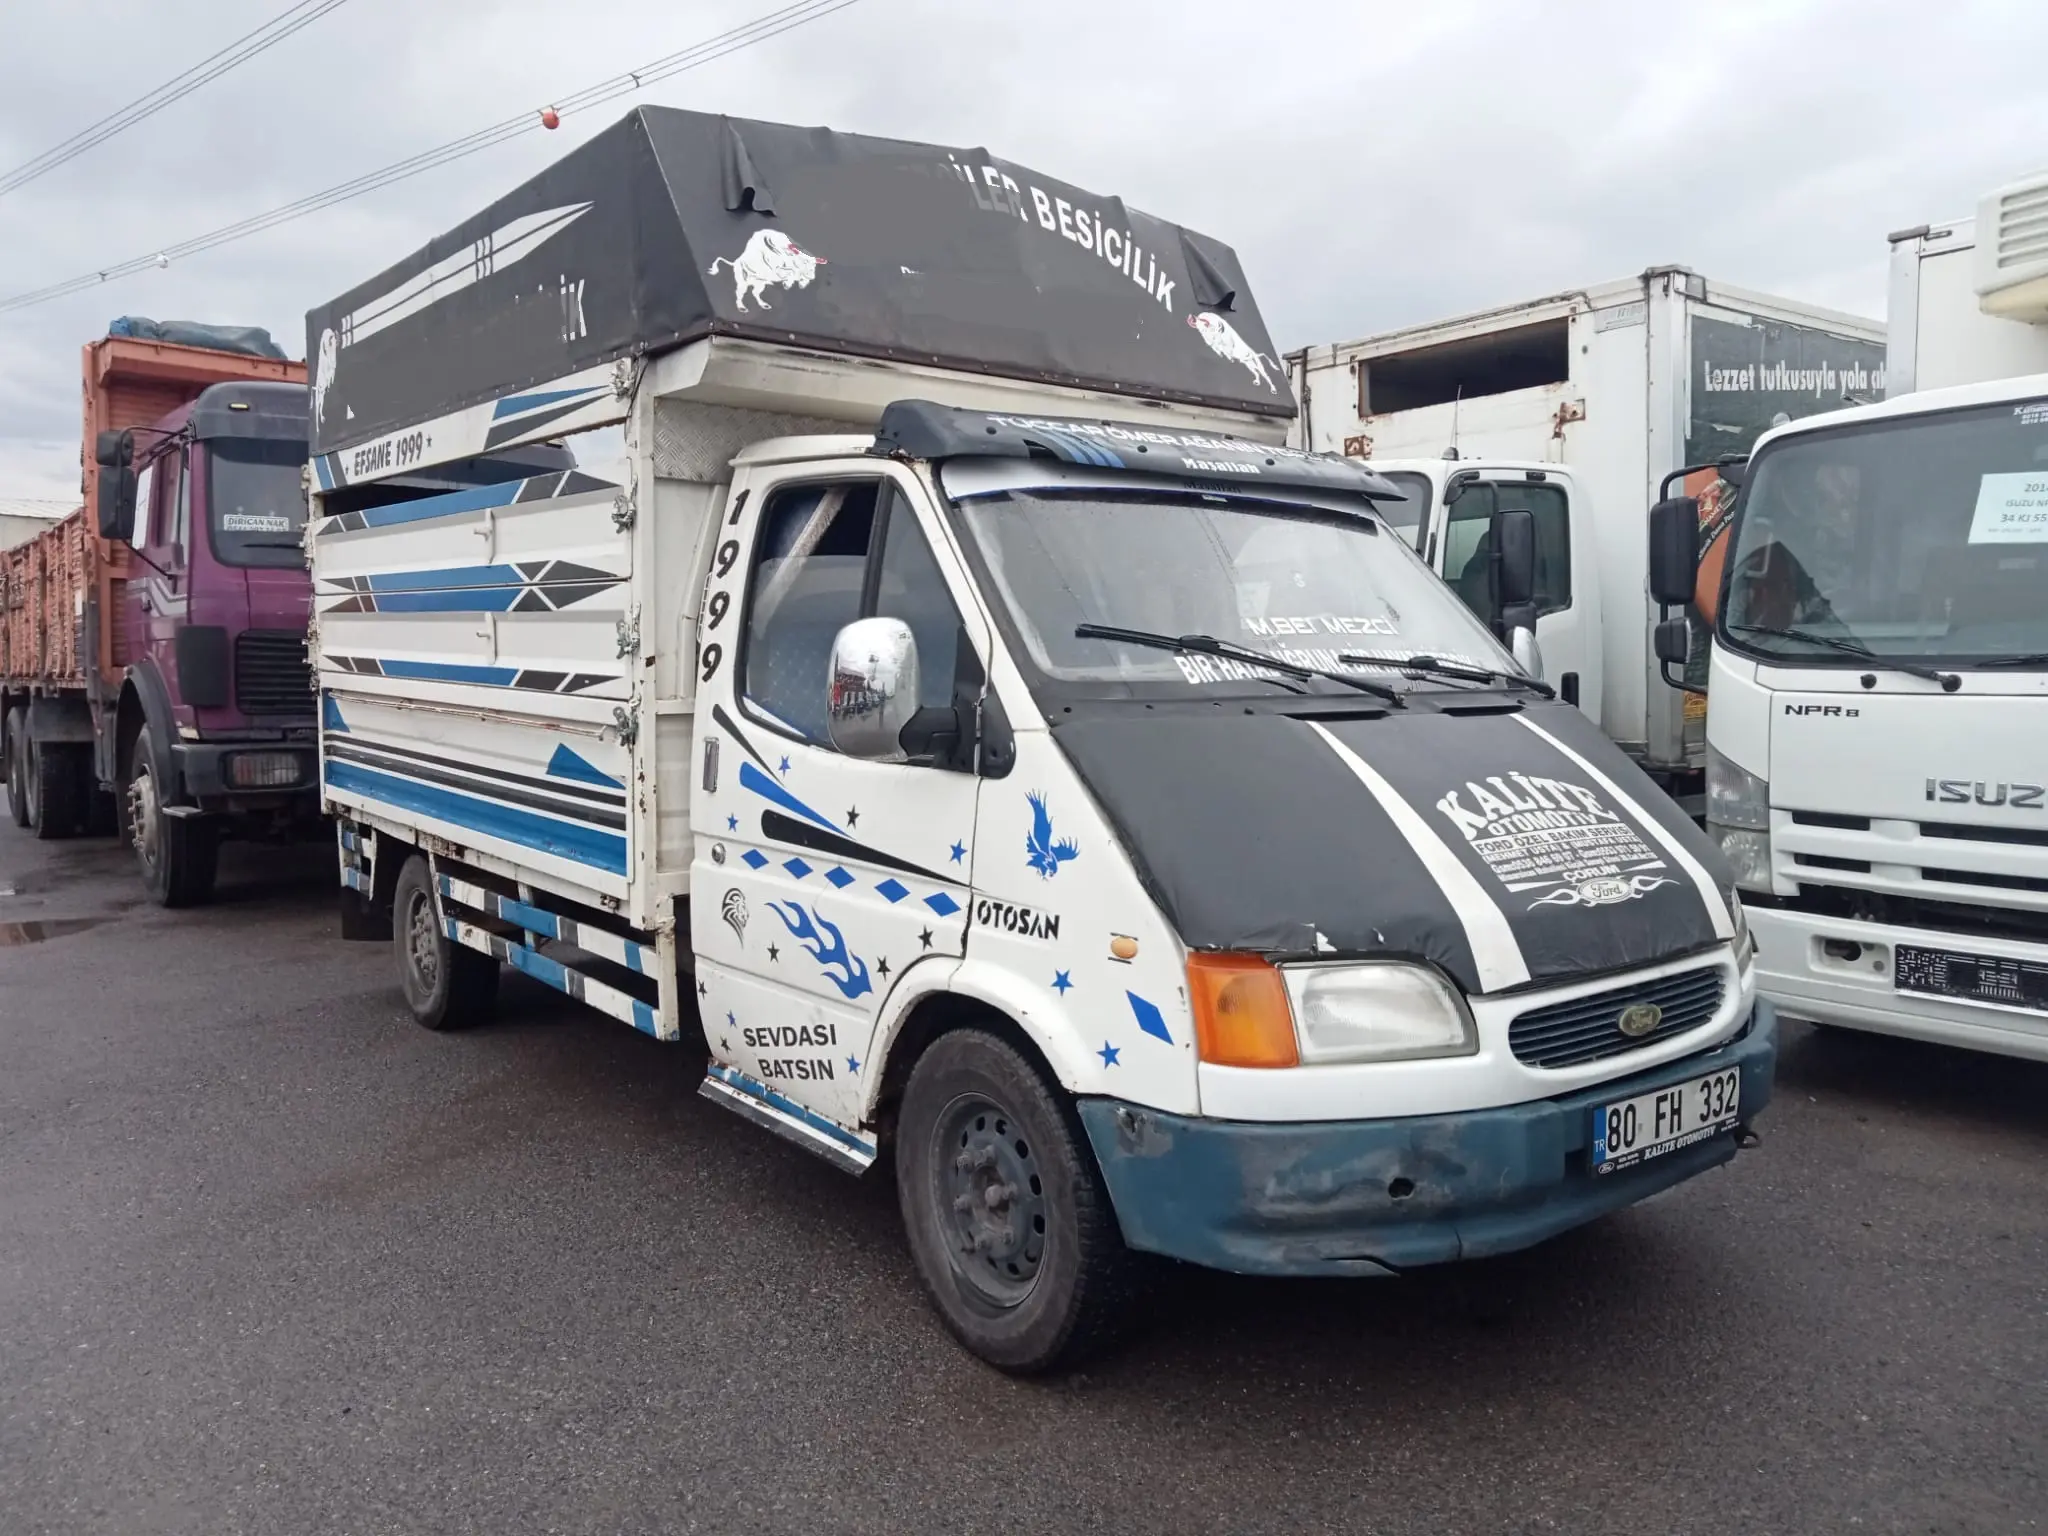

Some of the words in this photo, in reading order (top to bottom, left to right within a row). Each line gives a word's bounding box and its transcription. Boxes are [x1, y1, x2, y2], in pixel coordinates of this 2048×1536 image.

[1030, 186, 1175, 312] BESİCİLİK
[1704, 360, 1754, 391] Lezzet
[1760, 360, 1836, 398] tutkusuyla
[1840, 361, 1867, 399] yola
[354, 441, 392, 476] EFSANE
[396, 432, 423, 466] 1999
[1182, 457, 1260, 475] Maşallah
[702, 489, 751, 683] 1999
[1785, 704, 1842, 717] NPR
[1436, 771, 1620, 841] KALİTE
[1487, 810, 1598, 836] OTOMOTİV
[1475, 838, 1513, 855] FORD
[1511, 832, 1549, 848] ÖZEL
[1547, 827, 1588, 842] BAKIM
[1562, 864, 1621, 884] ÇORUM
[1591, 882, 1622, 898] Ford
[977, 899, 1060, 940] OTOSAN
[743, 1023, 837, 1047] SEVDASI
[757, 1058, 835, 1081] BATSIN
[1594, 1139, 1605, 1153] TR
[1608, 1107, 1637, 1153] 80
[1655, 1089, 1682, 1139] FH
[1699, 1071, 1737, 1122] 332
